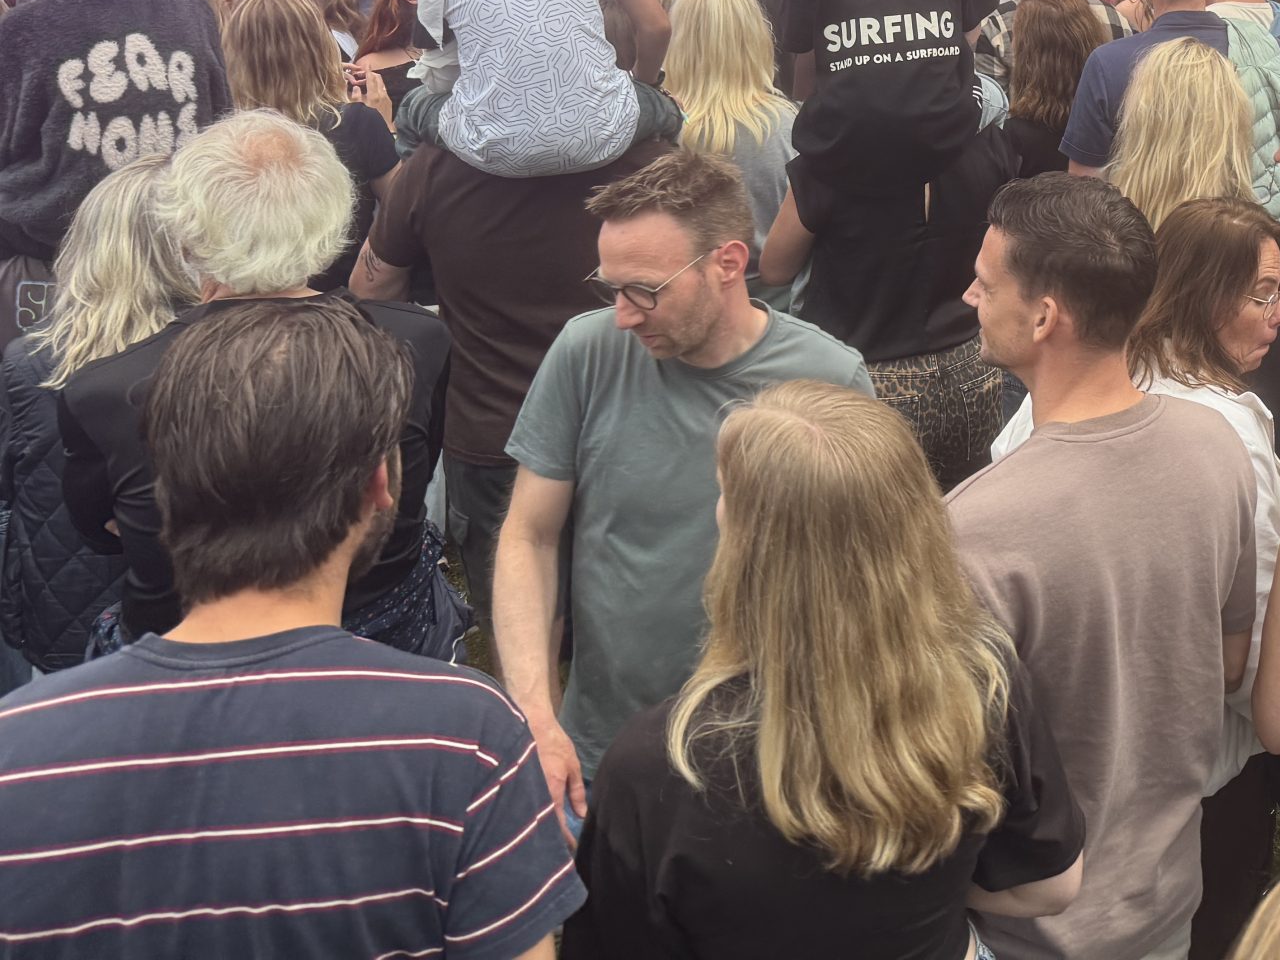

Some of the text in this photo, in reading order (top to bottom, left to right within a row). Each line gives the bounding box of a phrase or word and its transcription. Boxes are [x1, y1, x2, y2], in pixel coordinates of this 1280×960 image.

[823, 10, 955, 53] SURFING
[57, 33, 198, 108] FEAR
[829, 46, 961, 72] STAND UP ON A SURFBOARD
